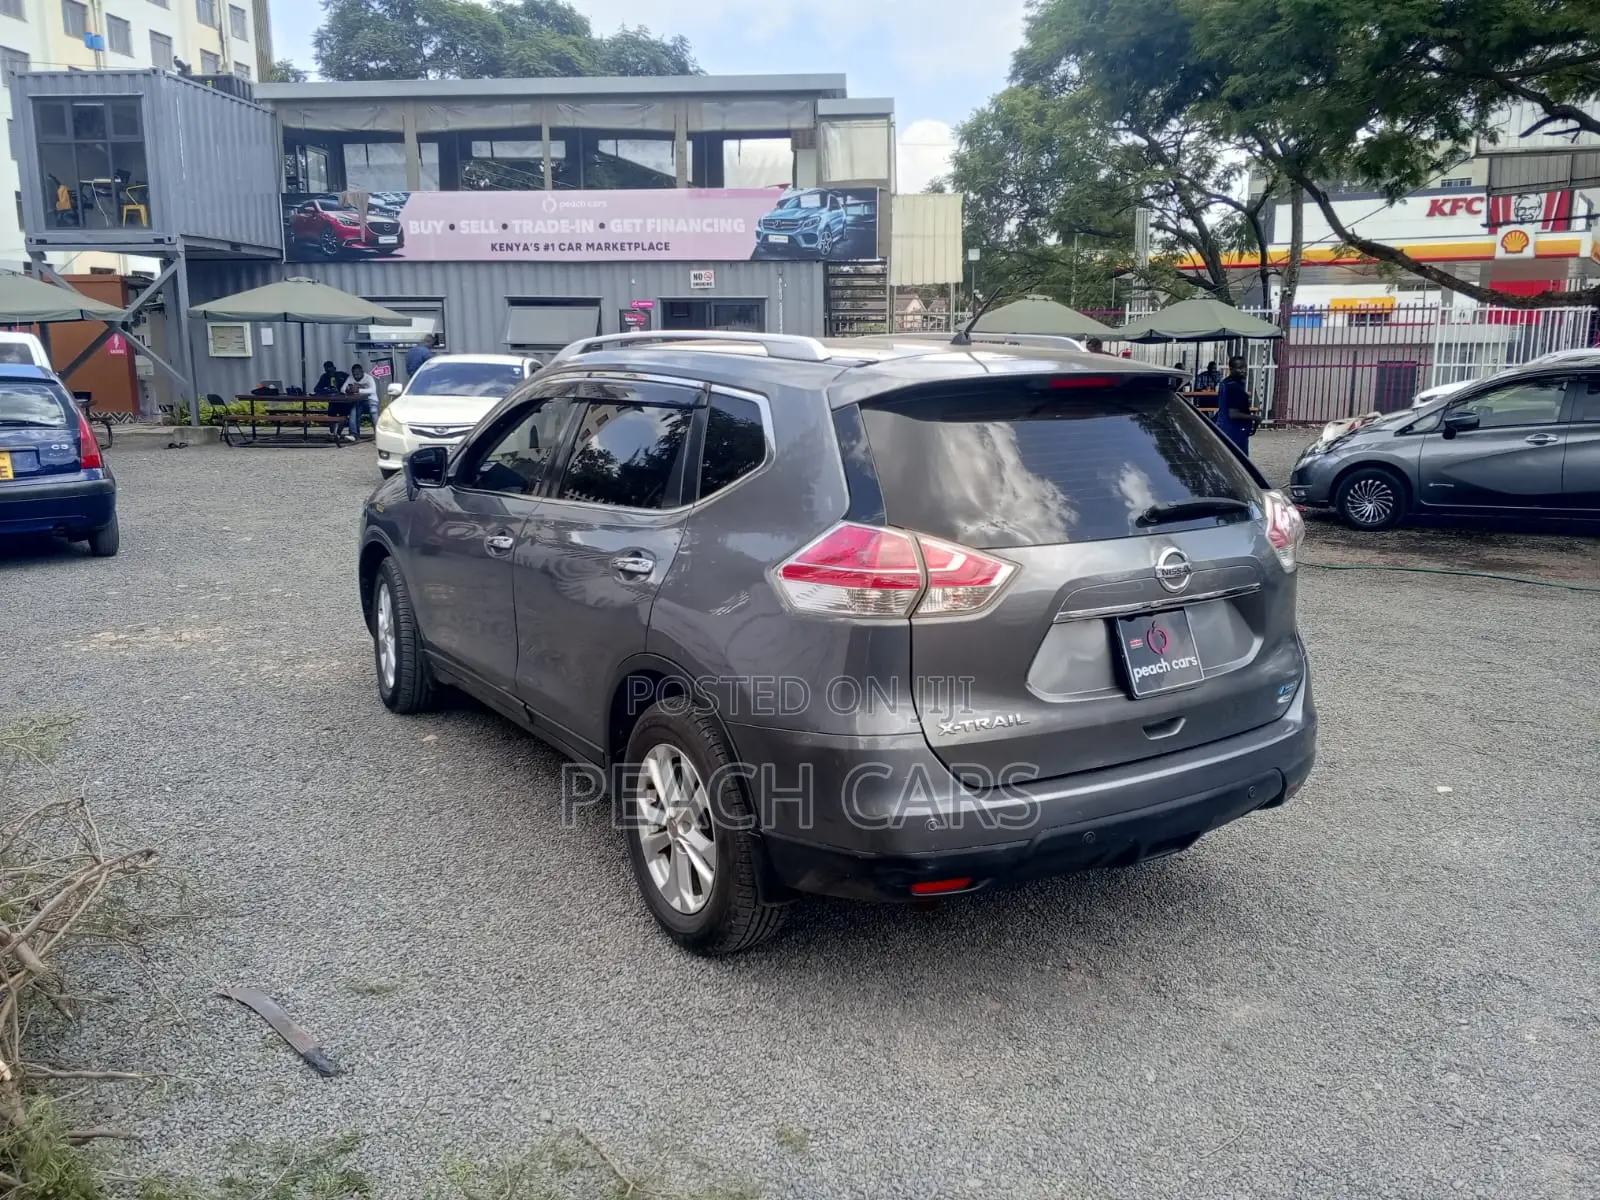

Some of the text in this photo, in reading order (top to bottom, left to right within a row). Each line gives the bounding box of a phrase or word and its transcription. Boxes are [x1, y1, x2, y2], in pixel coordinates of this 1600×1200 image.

[559, 199, 586, 211] peach
[1426, 196, 1485, 217] KFC
[408, 217, 746, 235] BUY SELL TRADE-IN GET FINANCING
[490, 242, 671, 252] KENYA'S #1 CAR MARKETPLACE
[693, 272, 703, 281] NO
[1133, 655, 1198, 683] peach cars
[936, 713, 1030, 736] X-TRAIL
